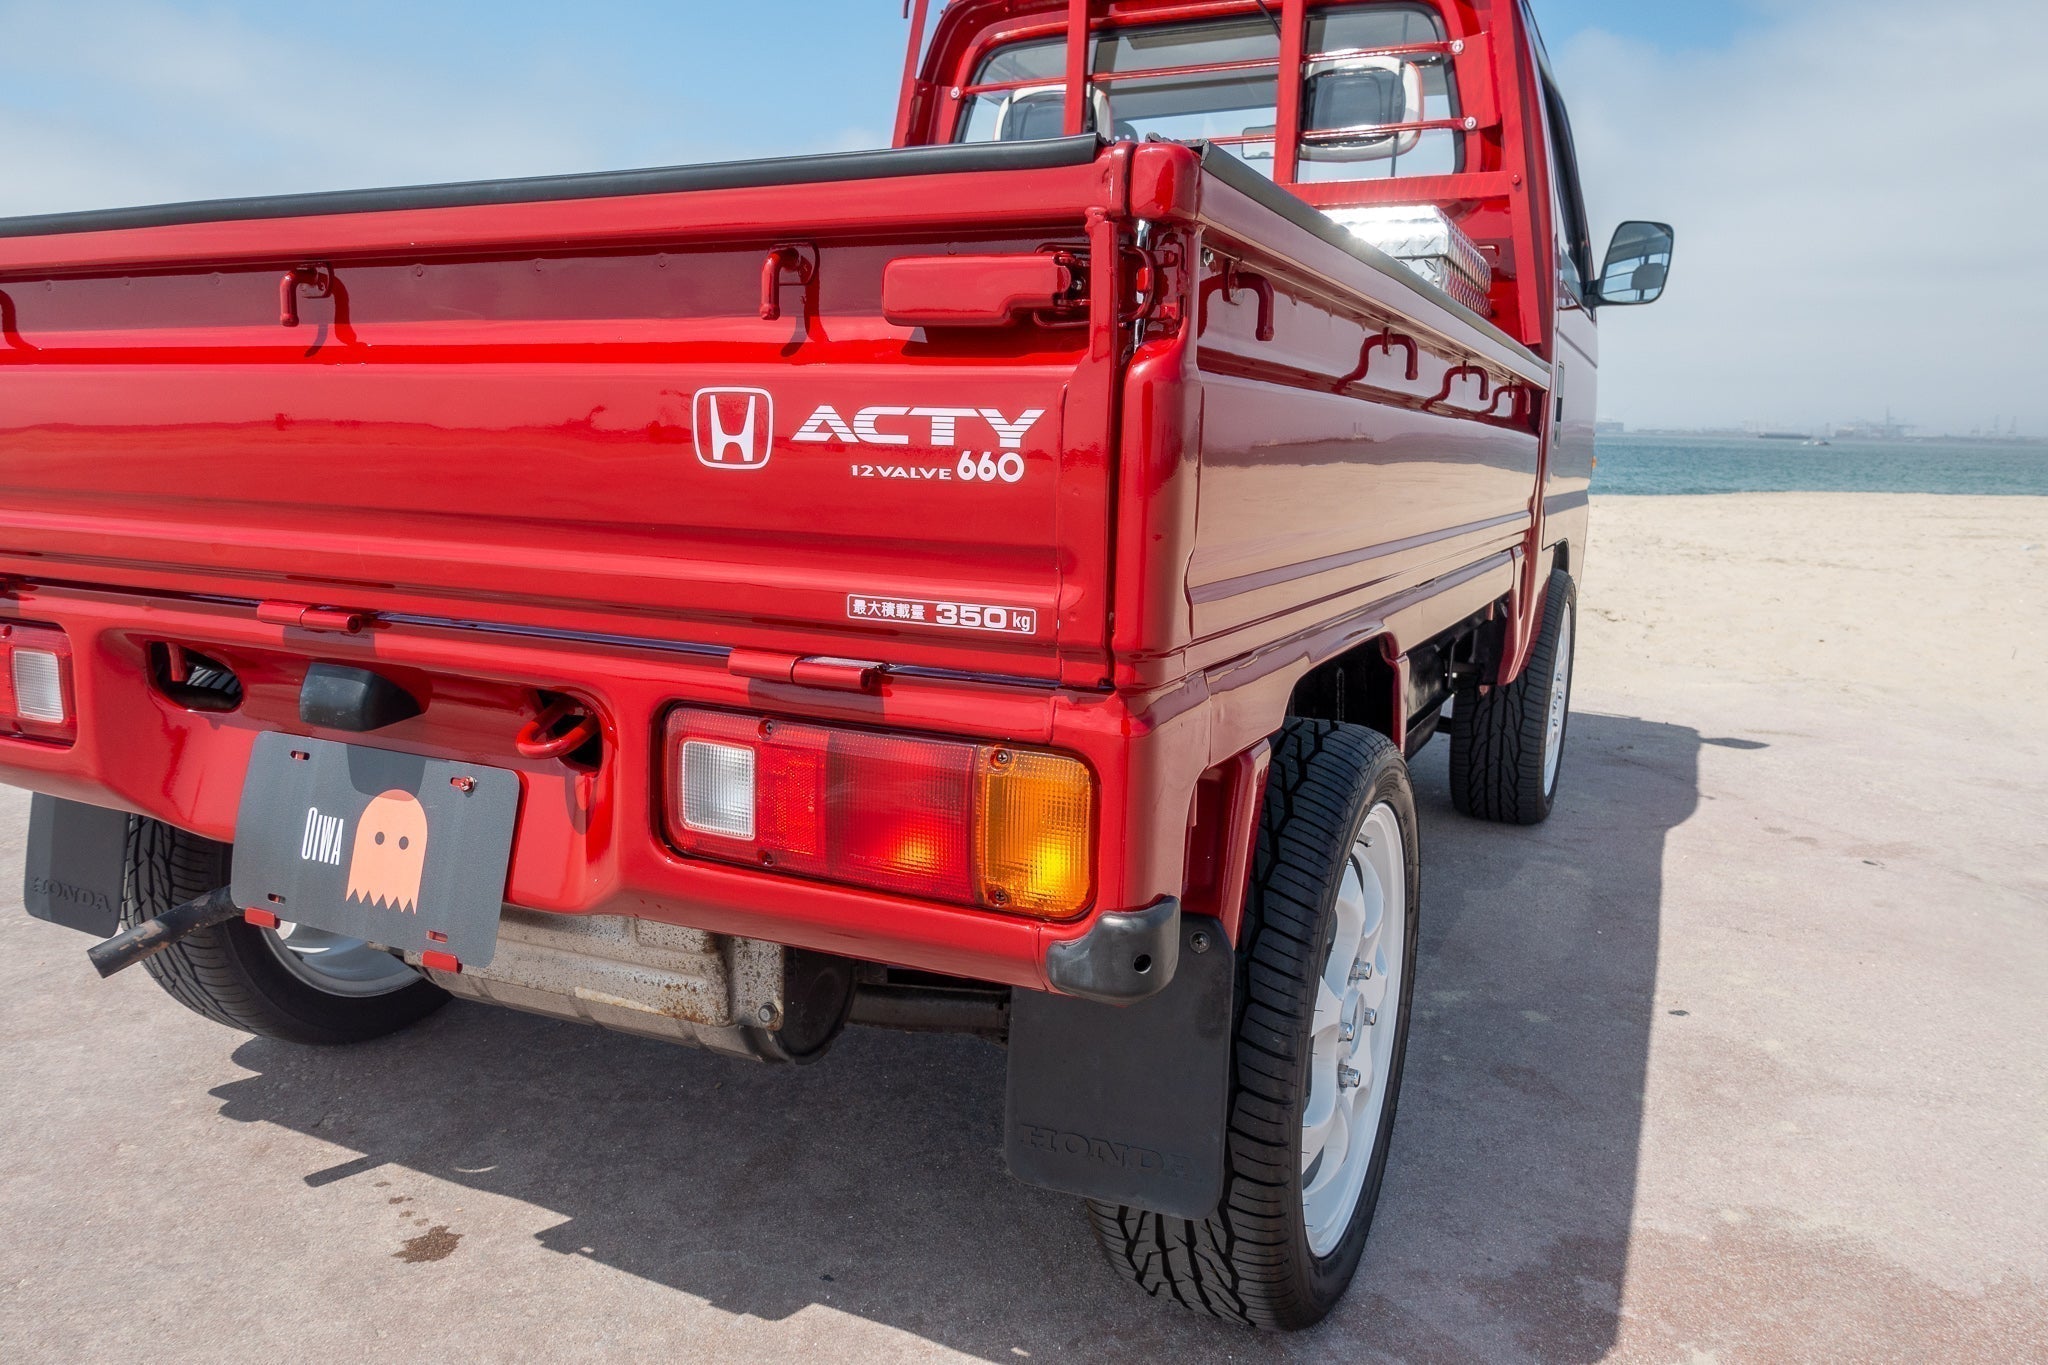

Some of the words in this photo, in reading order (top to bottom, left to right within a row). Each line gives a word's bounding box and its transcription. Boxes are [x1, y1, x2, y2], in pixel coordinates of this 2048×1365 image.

[791, 404, 1046, 448] ACTY
[956, 450, 1025, 483] 660
[853, 599, 925, 621] 最大積載量
[936, 604, 1007, 629] 350
[1012, 611, 1031, 631] kg
